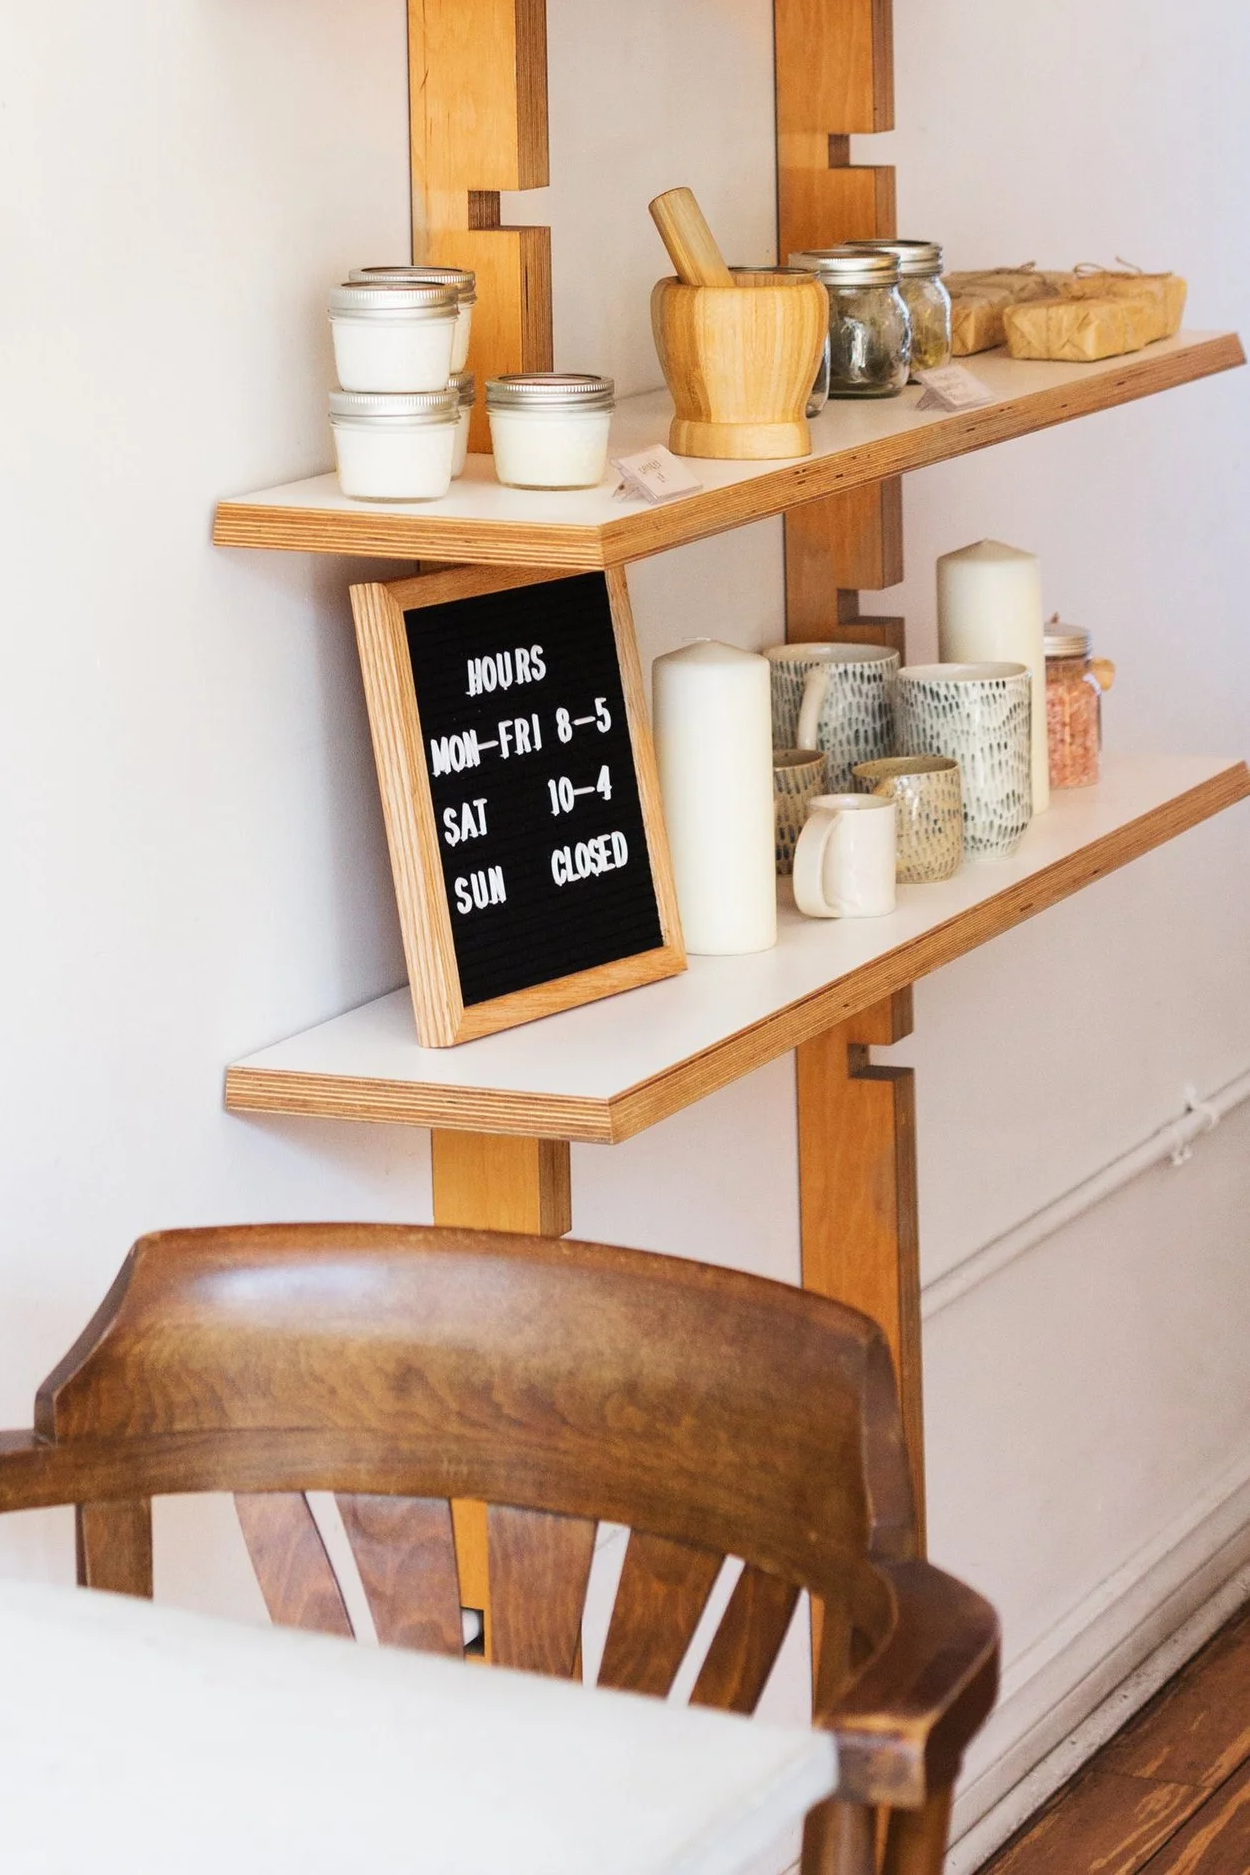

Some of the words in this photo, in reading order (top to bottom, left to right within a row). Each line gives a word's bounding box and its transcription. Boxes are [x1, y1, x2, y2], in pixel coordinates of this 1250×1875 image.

[466, 645, 547, 697] HOURS
[442, 797, 488, 848] SAT
[454, 865, 507, 915] SUN
[550, 830, 629, 887] CLOSED
